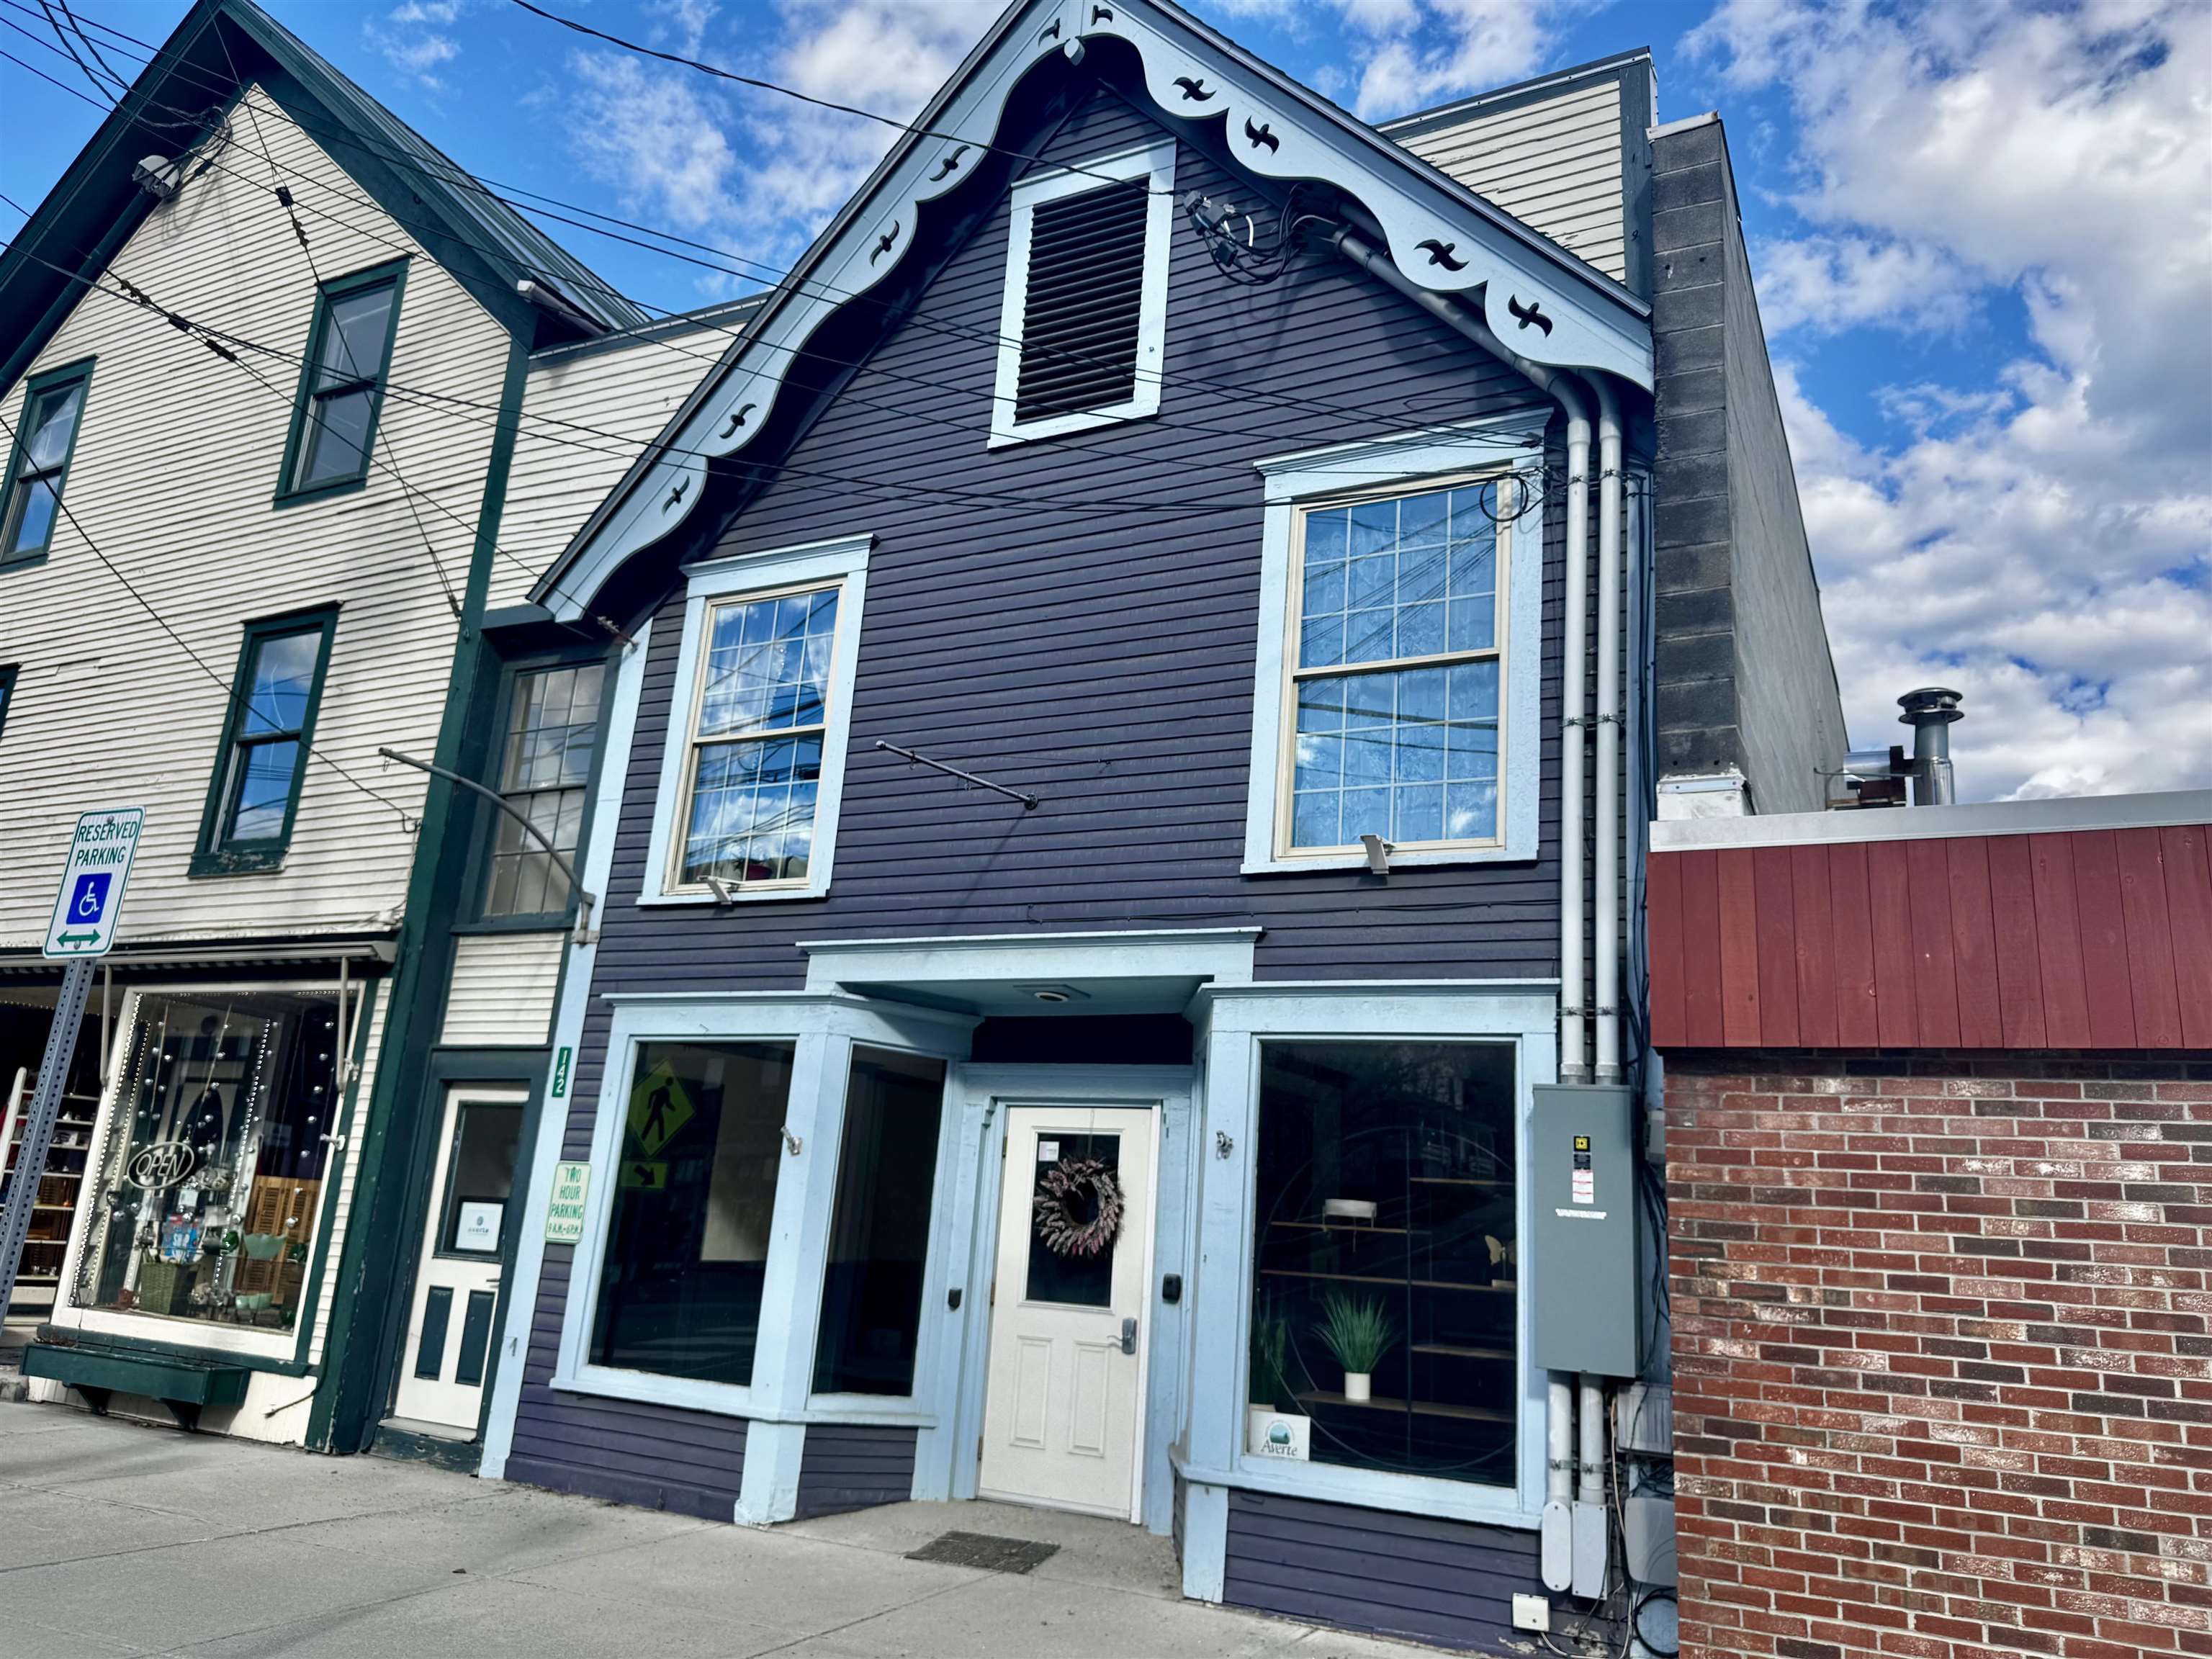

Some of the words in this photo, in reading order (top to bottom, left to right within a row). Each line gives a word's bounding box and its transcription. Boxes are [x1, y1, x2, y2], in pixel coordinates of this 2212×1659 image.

[77, 821, 138, 842] RESERVED
[75, 846, 126, 866] PARKING
[556, 1050, 567, 1094] 142
[135, 1153, 185, 1176] OPEN
[564, 1167, 582, 1182] TWO
[559, 1184, 581, 1200] HOUR
[550, 1203, 584, 1219] PARKING
[1261, 1439, 1298, 1456] Averte
